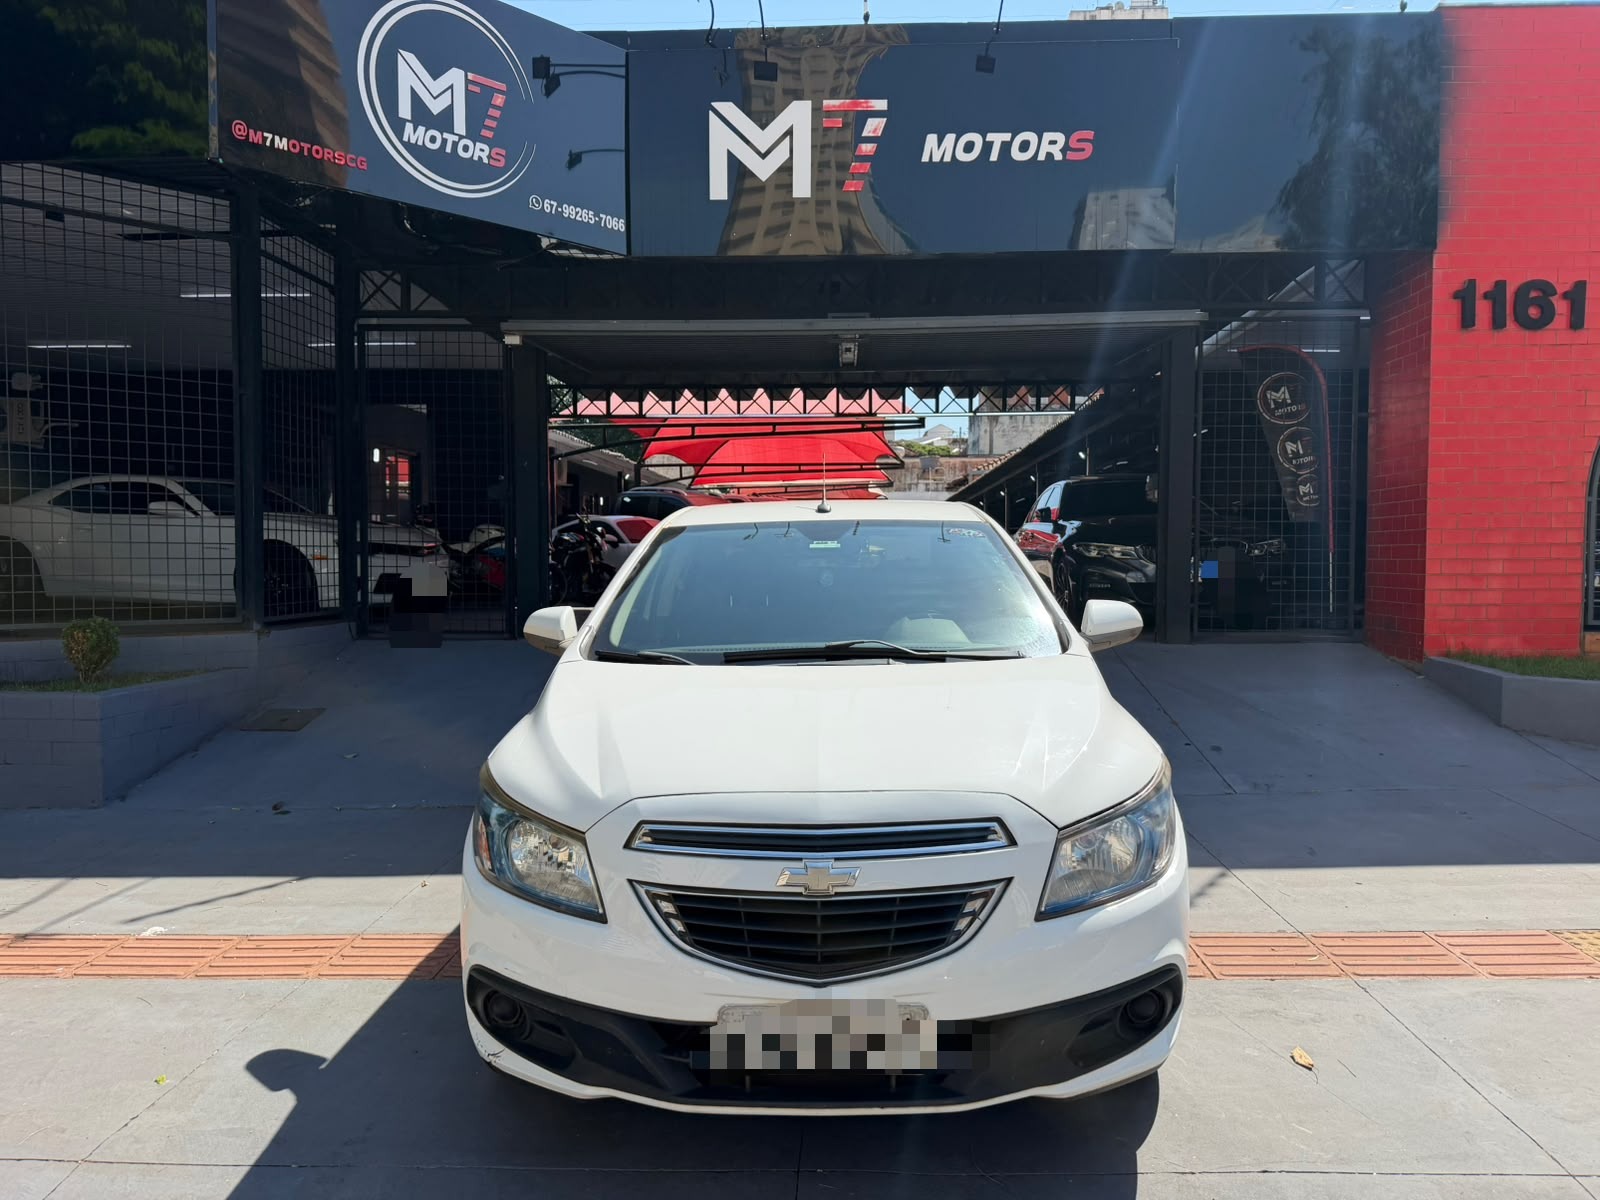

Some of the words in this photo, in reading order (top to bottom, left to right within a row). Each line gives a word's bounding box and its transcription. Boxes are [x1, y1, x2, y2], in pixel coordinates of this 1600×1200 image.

[398, 49, 507, 138] M7
[231, 120, 367, 170] @M7MOTORSCG
[403, 122, 506, 168] MOTORS
[709, 99, 888, 200] M7
[921, 130, 1095, 163] MOTORS
[543, 199, 626, 232] 67-99265-7066
[1453, 279, 1587, 331] 1161
